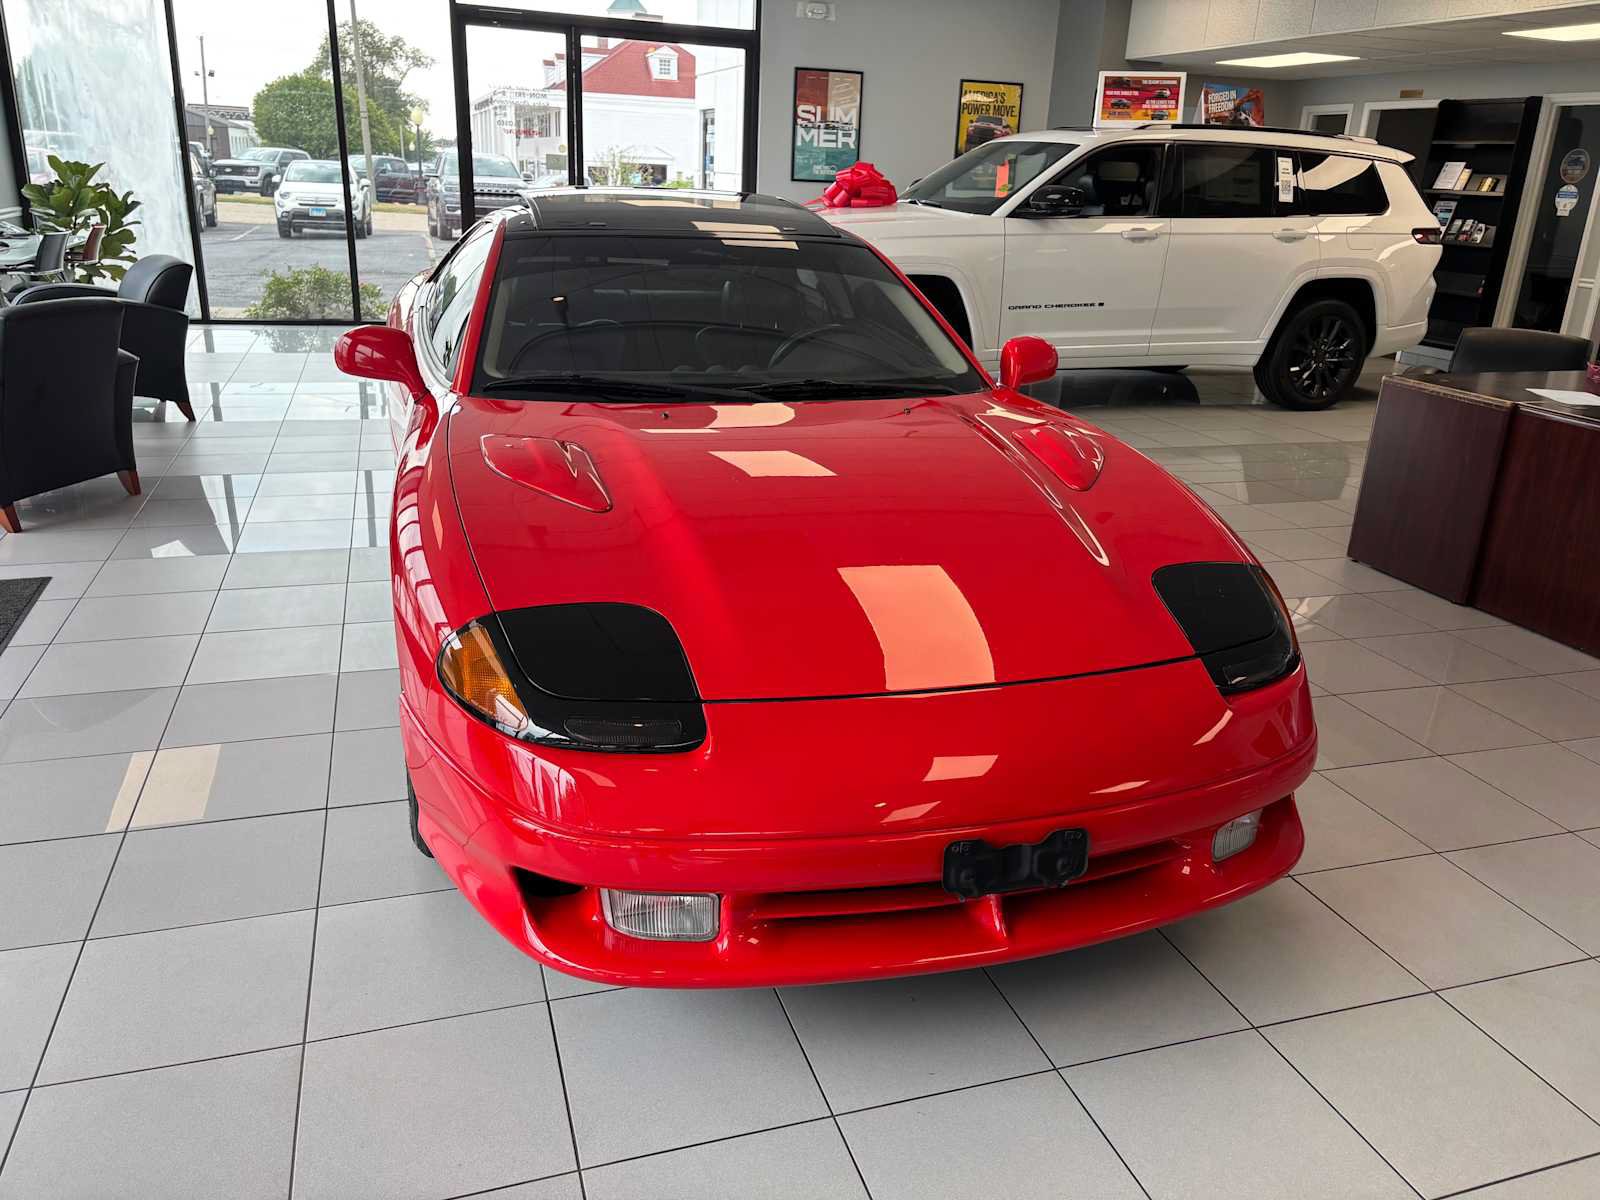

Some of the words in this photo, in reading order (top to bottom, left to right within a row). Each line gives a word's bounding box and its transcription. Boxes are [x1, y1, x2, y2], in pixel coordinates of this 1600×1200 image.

[1208, 91, 1230, 103] FORGED
[961, 103, 991, 115] POWER
[1208, 101, 1234, 113] FREEDOM
[797, 127, 856, 149] MER
